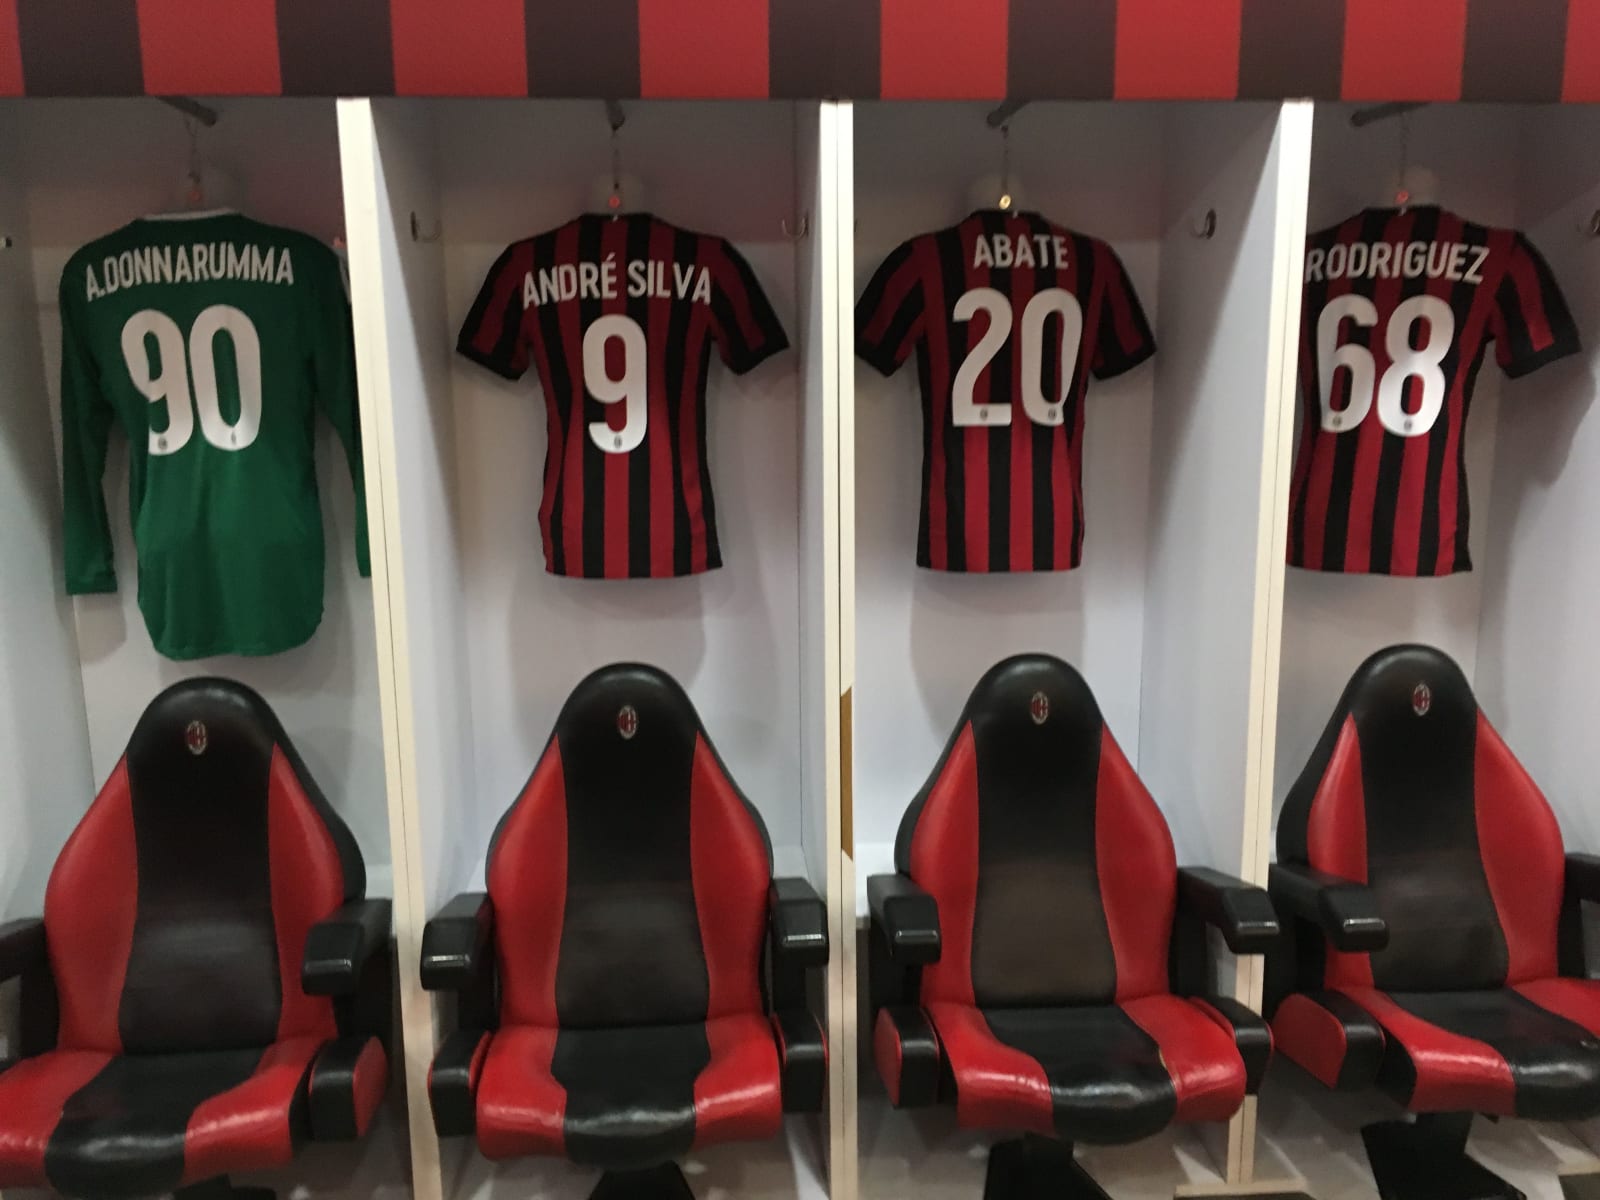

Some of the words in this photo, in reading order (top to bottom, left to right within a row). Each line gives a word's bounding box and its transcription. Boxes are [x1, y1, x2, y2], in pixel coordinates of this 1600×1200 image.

[86, 241, 294, 302] A.DONNARUMMA
[523, 253, 617, 310] ANDRÉ
[627, 259, 711, 305] SILVA
[973, 233, 1069, 269] ABATE
[1304, 240, 1490, 285] RODRIGUEZ
[121, 304, 262, 456] 90
[583, 314, 647, 454] 9
[952, 287, 1083, 427] 20
[1317, 294, 1455, 437] 68
